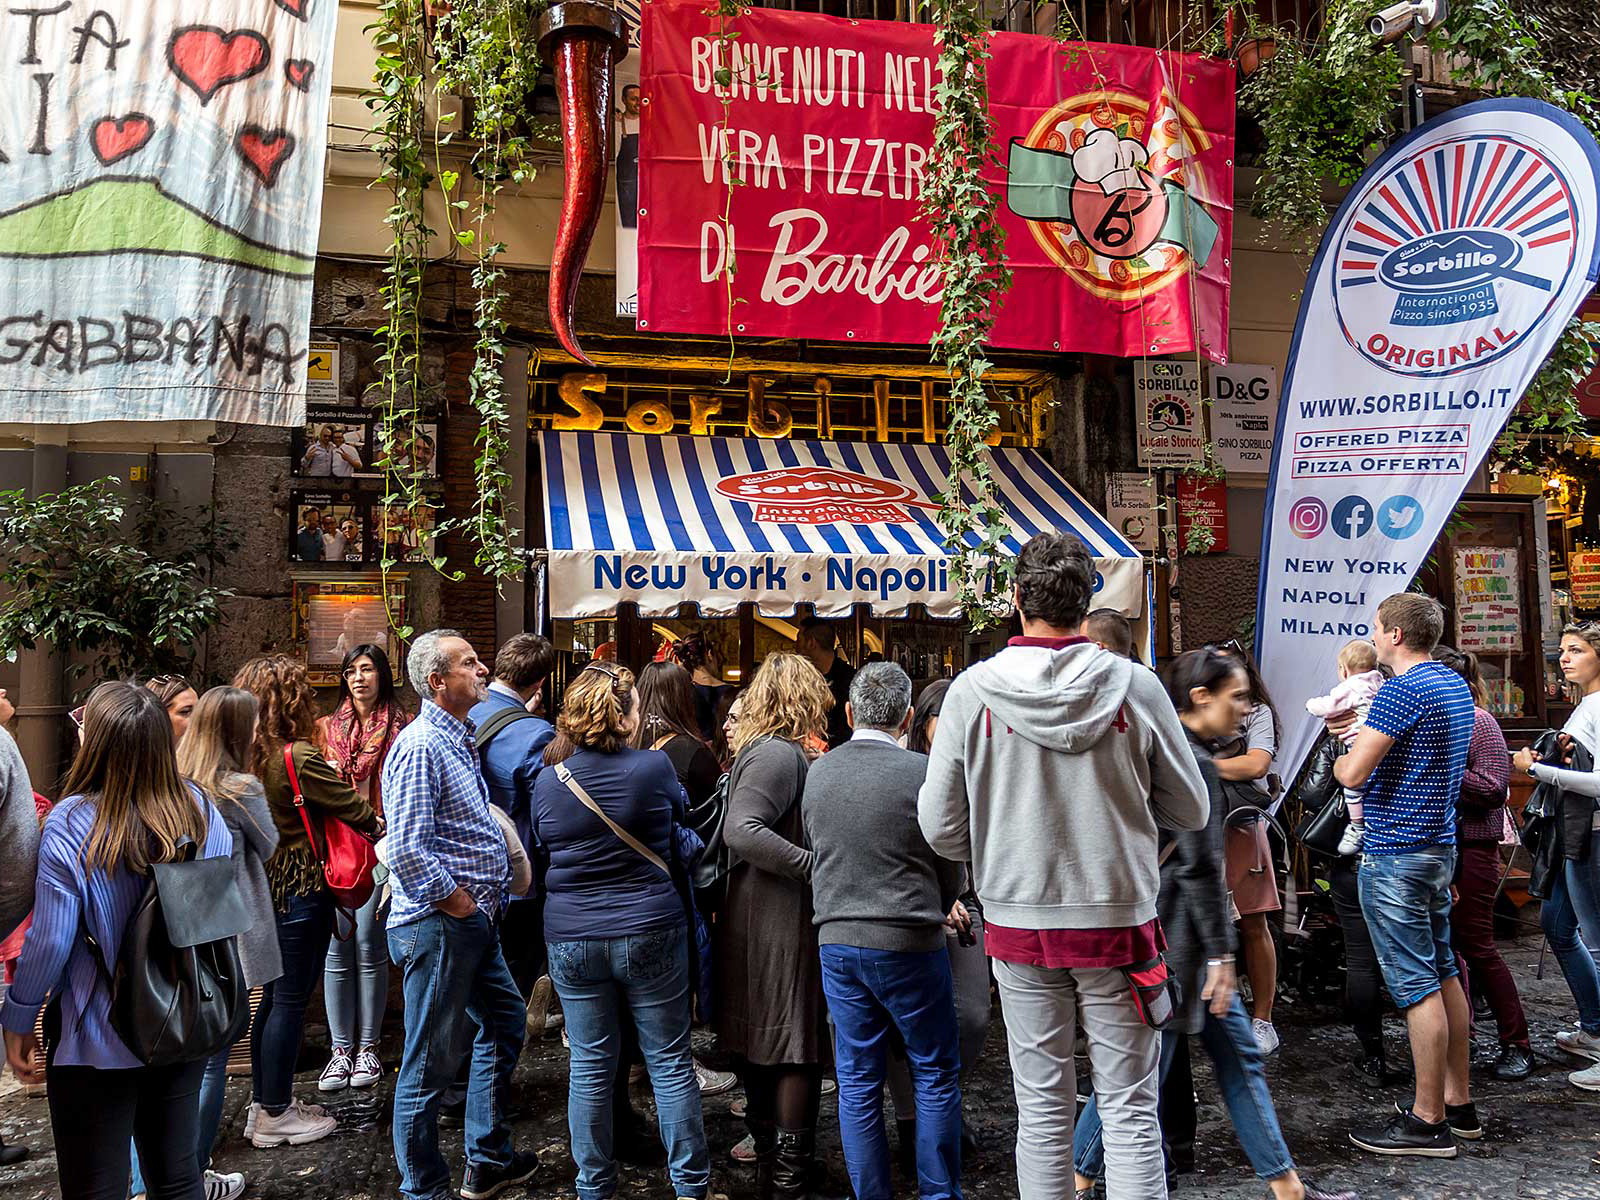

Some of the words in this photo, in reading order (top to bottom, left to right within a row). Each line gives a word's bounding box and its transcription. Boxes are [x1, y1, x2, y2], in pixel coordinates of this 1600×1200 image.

[691, 36, 865, 109] BENVENUTI
[885, 52, 943, 115] NEL
[698, 123, 787, 190] VERA
[803, 134, 935, 201] PIZZER
[701, 221, 736, 283] DI
[761, 208, 943, 305] Barbie
[1393, 252, 1497, 278] Sorbillo
[1400, 287, 1490, 307] International
[1393, 310, 1424, 320] Pizza
[0, 310, 307, 384] GABBANA
[1366, 327, 1519, 368] ORIGINAL
[1153, 364, 1183, 376] GNO
[1139, 379, 1198, 391] SORBILLO
[1216, 376, 1270, 401] D&G
[1300, 388, 1511, 419] WWW.SORBILLO.IT
[1218, 438, 1239, 449] GINO
[1239, 438, 1273, 449] SORBILLO
[1300, 433, 1390, 448] OFFERED
[1398, 430, 1464, 443] PIZZA
[1240, 452, 1263, 460] PIZZA
[1297, 460, 1352, 473] PIZZA
[1361, 457, 1460, 471] OFFERTA
[738, 481, 886, 495] Sorbillo
[761, 504, 896, 515] International
[758, 514, 809, 523] Pizza
[1285, 558, 1334, 573] NEW
[1344, 559, 1407, 575] YORK
[593, 556, 686, 590] New
[701, 556, 786, 590] York
[826, 557, 948, 600] Napoli
[1282, 588, 1366, 605] NAPOLI
[1281, 619, 1369, 636] MILANO
